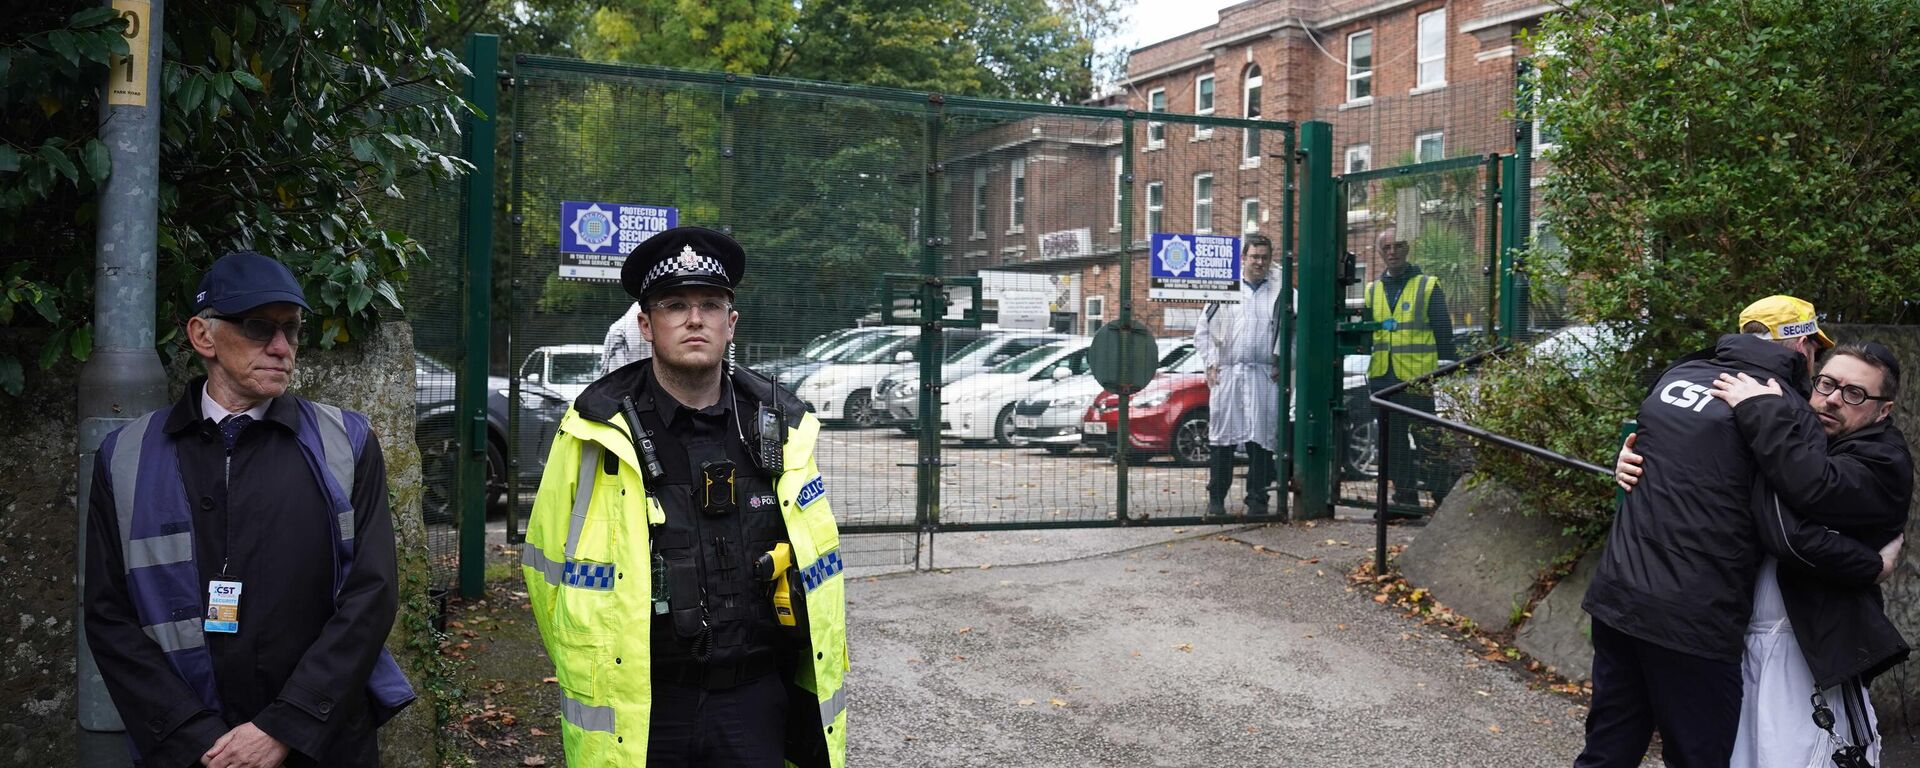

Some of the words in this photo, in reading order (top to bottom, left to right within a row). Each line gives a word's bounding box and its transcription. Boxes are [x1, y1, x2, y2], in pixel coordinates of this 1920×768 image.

[120, 54, 134, 82] 1
[619, 206, 657, 217] PROTECTED
[657, 209, 668, 218] BY
[619, 214, 668, 231] SECTOR
[1195, 244, 1233, 258] SECTOR
[1194, 257, 1233, 268] SECURITY
[1194, 267, 1233, 278] SERVICES
[1660, 379, 1716, 413] CST
[797, 480, 825, 504] POLIC
[216, 586, 236, 595] CST
